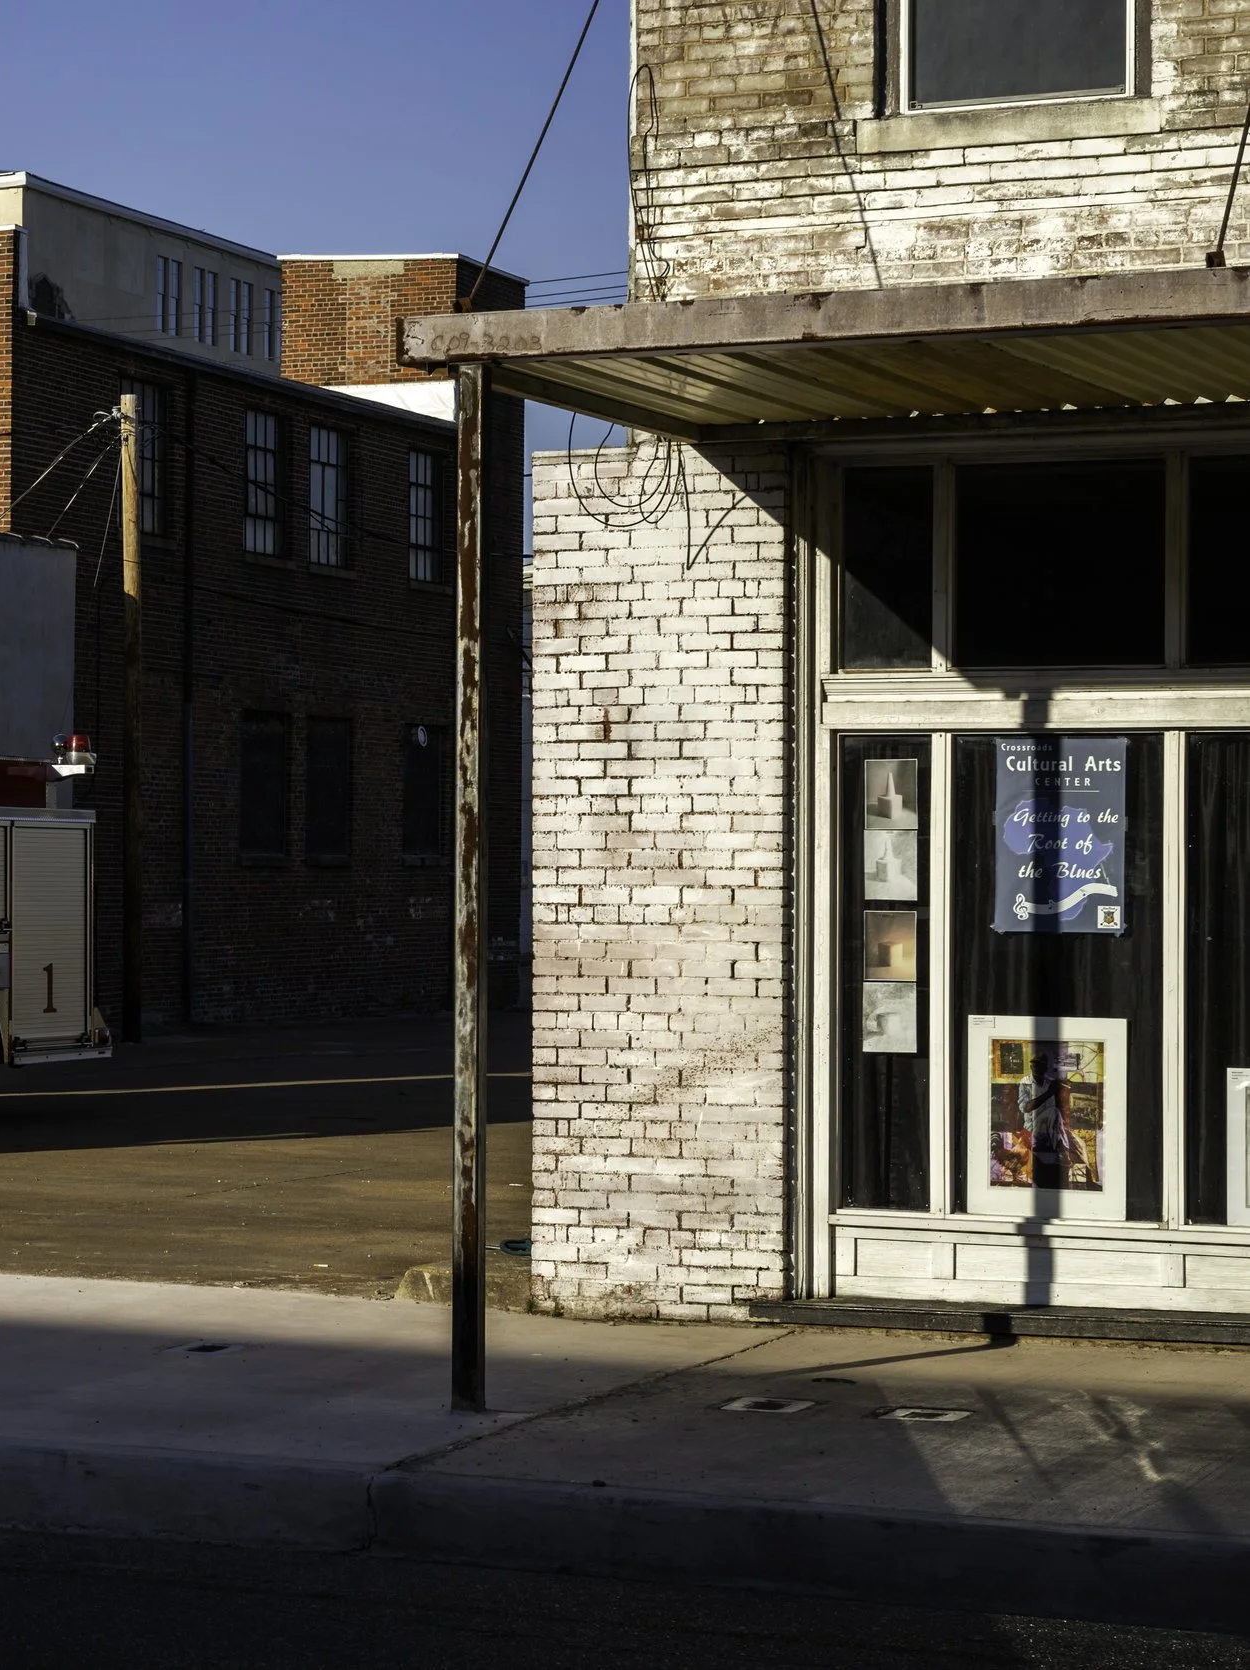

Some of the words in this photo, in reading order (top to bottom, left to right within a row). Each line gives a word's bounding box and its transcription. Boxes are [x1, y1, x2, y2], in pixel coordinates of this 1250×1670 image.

[1001, 743, 1053, 751] Crossroads
[1006, 756, 1073, 771] Cultural
[1084, 756, 1121, 772] Arts
[1035, 777, 1091, 786] CENTER
[1013, 808, 1070, 827] Getting
[1077, 811, 1090, 823] to
[1097, 808, 1119, 823] the
[1027, 834, 1068, 853] Root
[1075, 834, 1093, 855] of
[1018, 861, 1043, 878] the
[1051, 862, 1101, 879] Blues
[43, 962, 57, 1013] 1
